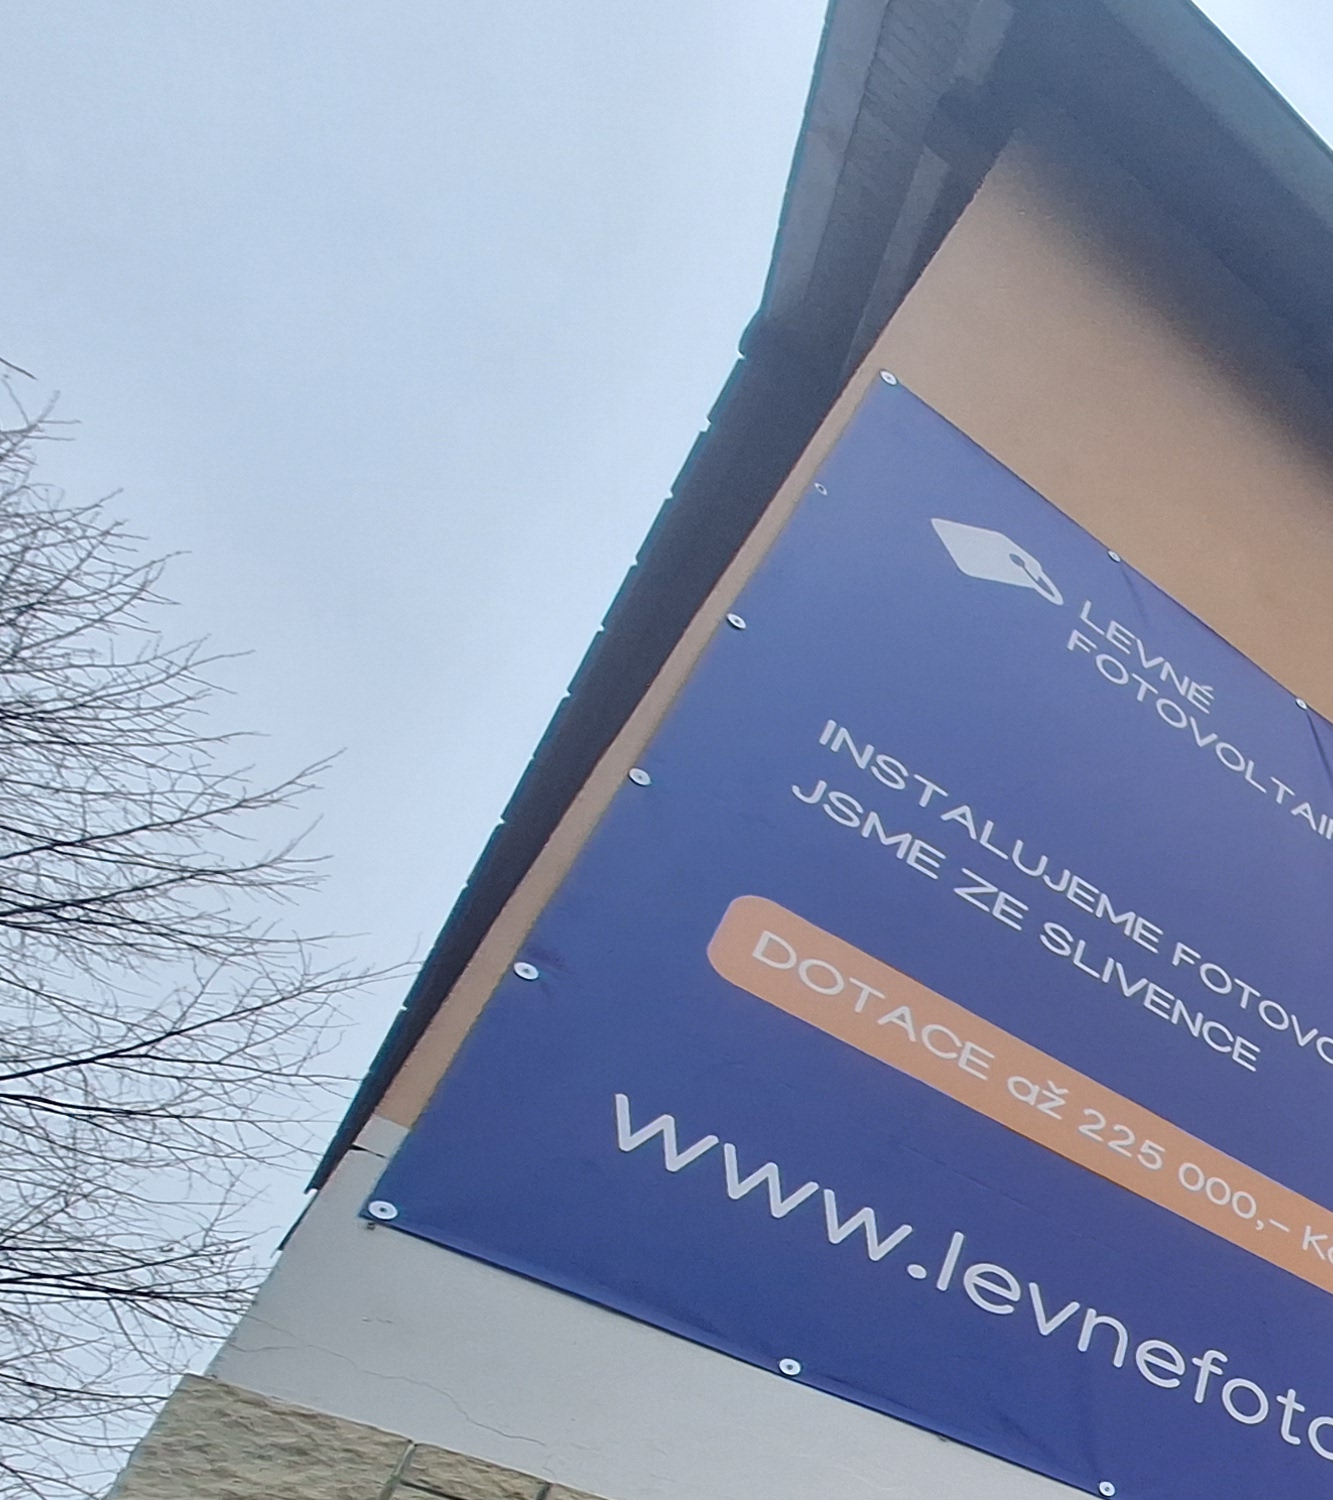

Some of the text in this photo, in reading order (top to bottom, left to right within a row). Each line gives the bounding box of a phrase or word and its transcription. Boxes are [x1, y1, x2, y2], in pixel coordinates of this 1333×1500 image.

[1078, 600, 1215, 714] LEVNÉ
[791, 779, 1262, 1072] JSME ZE SLIVENCE
[818, 719, 1164, 955] INSTALUJEME
[752, 930, 996, 1081] DOTACE
[1006, 1075, 1068, 1121] až
[1077, 1107, 1166, 1171] 225
